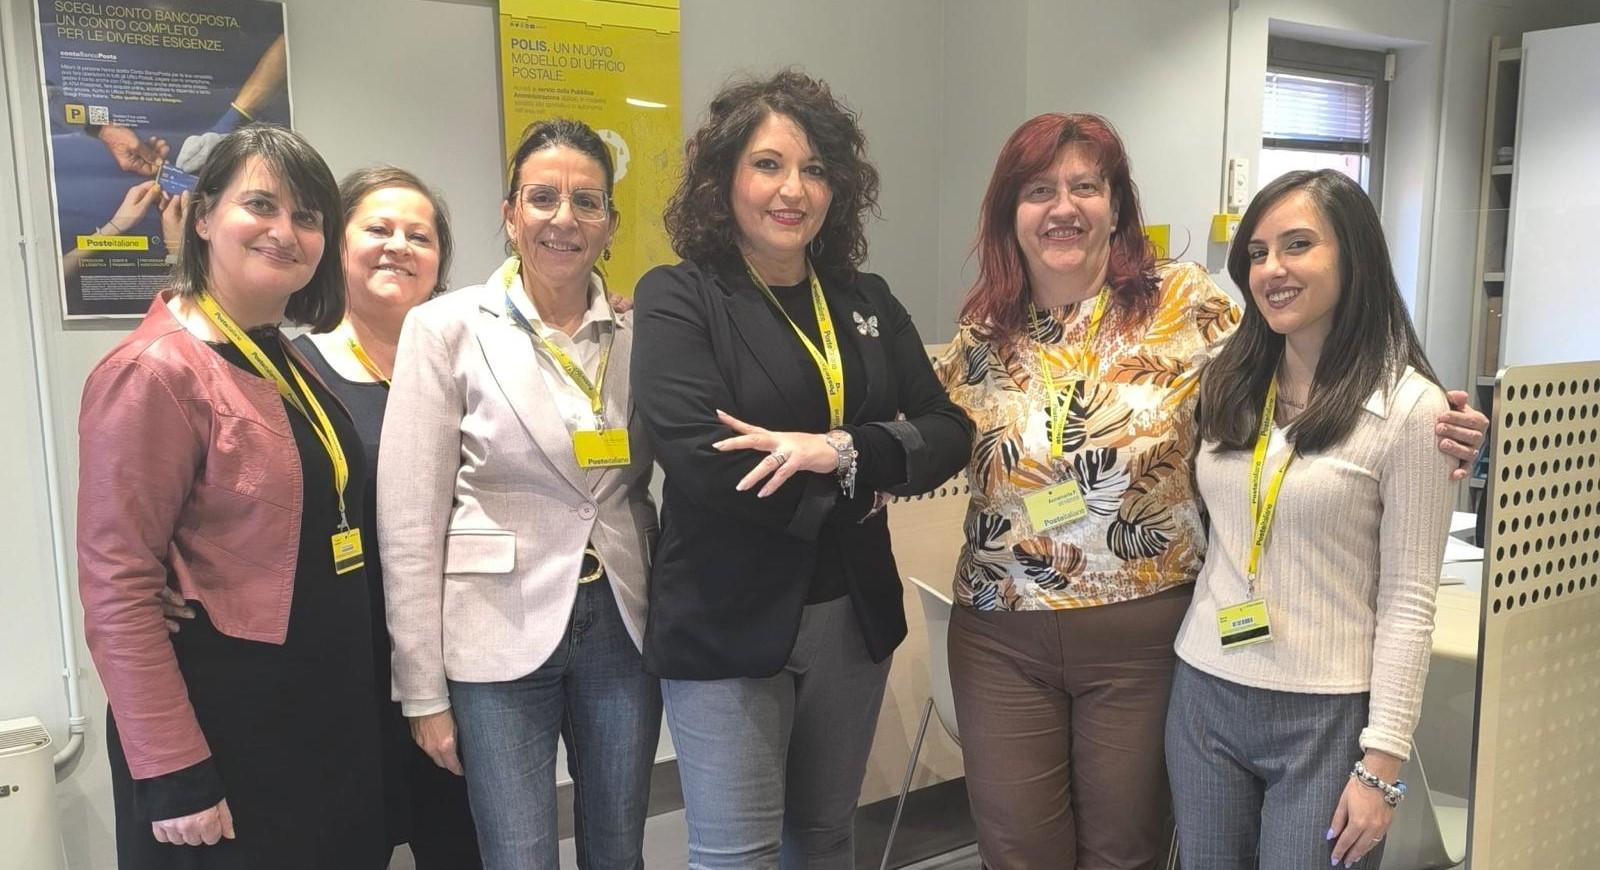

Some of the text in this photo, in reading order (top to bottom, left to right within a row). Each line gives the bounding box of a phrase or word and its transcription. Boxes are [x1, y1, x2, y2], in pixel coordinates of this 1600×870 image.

[55, 1, 241, 28] SCEGLI CONTO BANCOPOSTA.
[56, 15, 199, 36] UN CONTO COMPLETO
[57, 28, 225, 52] PER LE DIVERSE ESIGENZE.
[511, 38, 613, 57] POLIS. UN NUOVO
[512, 53, 625, 73] MODELLO DI UFFICIO
[512, 67, 566, 82] POSTALE.
[87, 239, 140, 247] Posteitaliane
